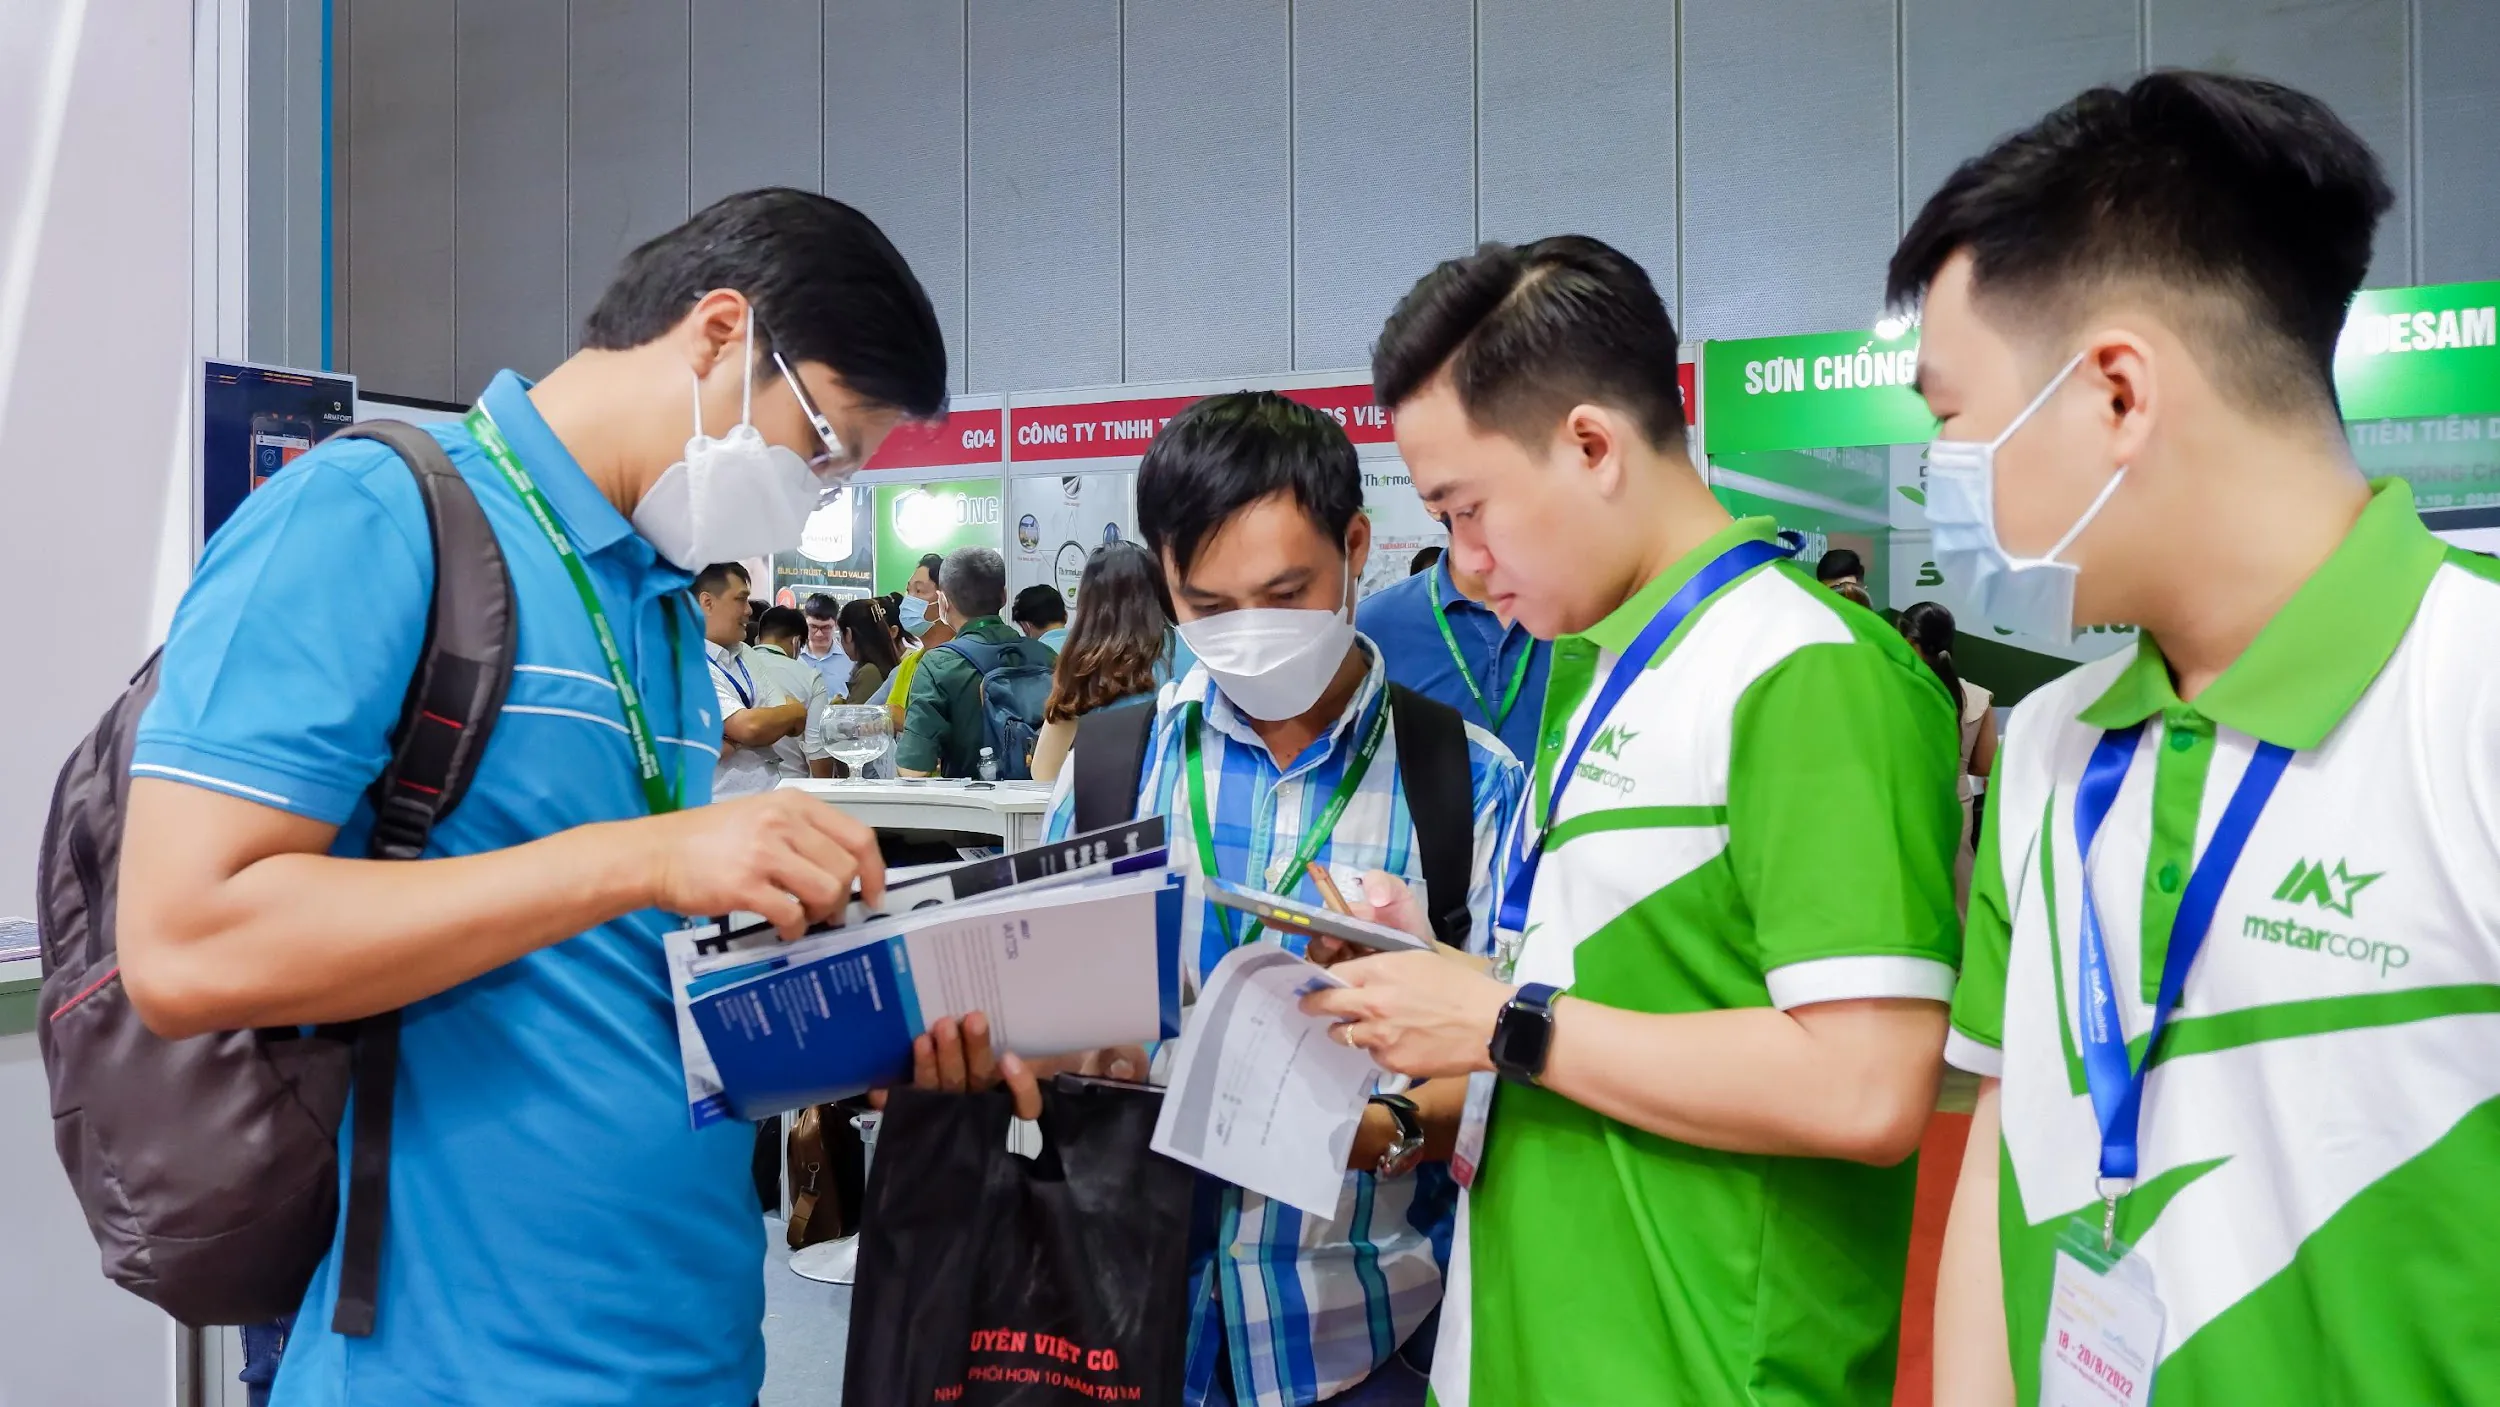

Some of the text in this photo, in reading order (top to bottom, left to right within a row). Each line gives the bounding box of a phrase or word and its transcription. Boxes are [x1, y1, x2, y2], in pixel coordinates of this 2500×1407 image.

[2362, 306, 2496, 356] DESAM
[1744, 340, 1918, 395] SƠN CHỐNG
[1017, 421, 1068, 447] CÔNG
[1072, 422, 1098, 443] TY
[1101, 418, 1154, 442] TNHH
[1353, 405, 1397, 430] VIỆ
[828, 571, 847, 579] BUILD
[2241, 912, 2410, 979] mstarcorp
[1034, 1333, 1081, 1364] VIỆT
